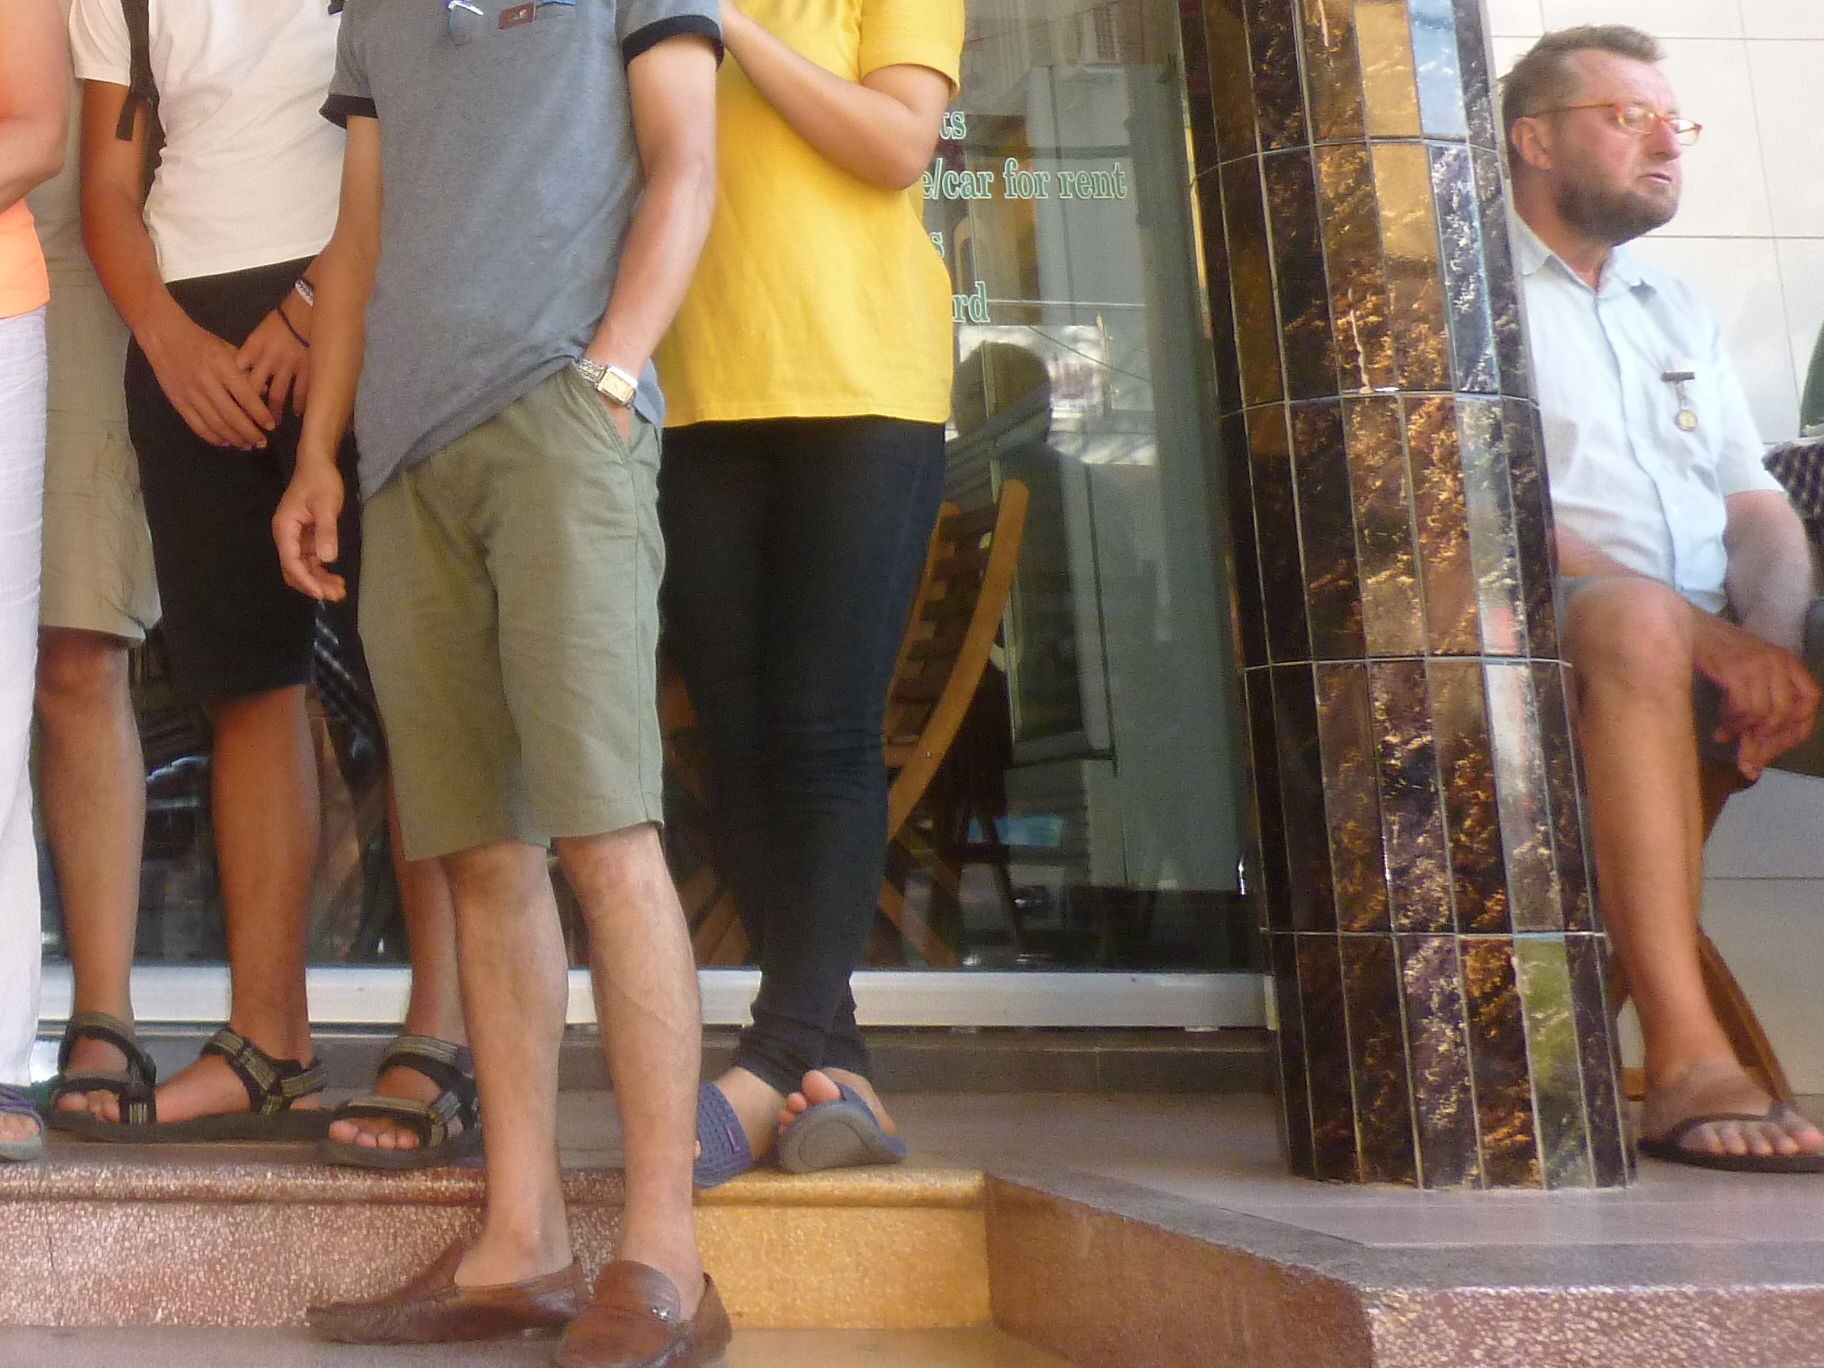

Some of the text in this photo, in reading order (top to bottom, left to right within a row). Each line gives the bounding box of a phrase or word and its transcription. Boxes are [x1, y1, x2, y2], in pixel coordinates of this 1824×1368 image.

[922, 157, 1127, 201] e/car for rent
